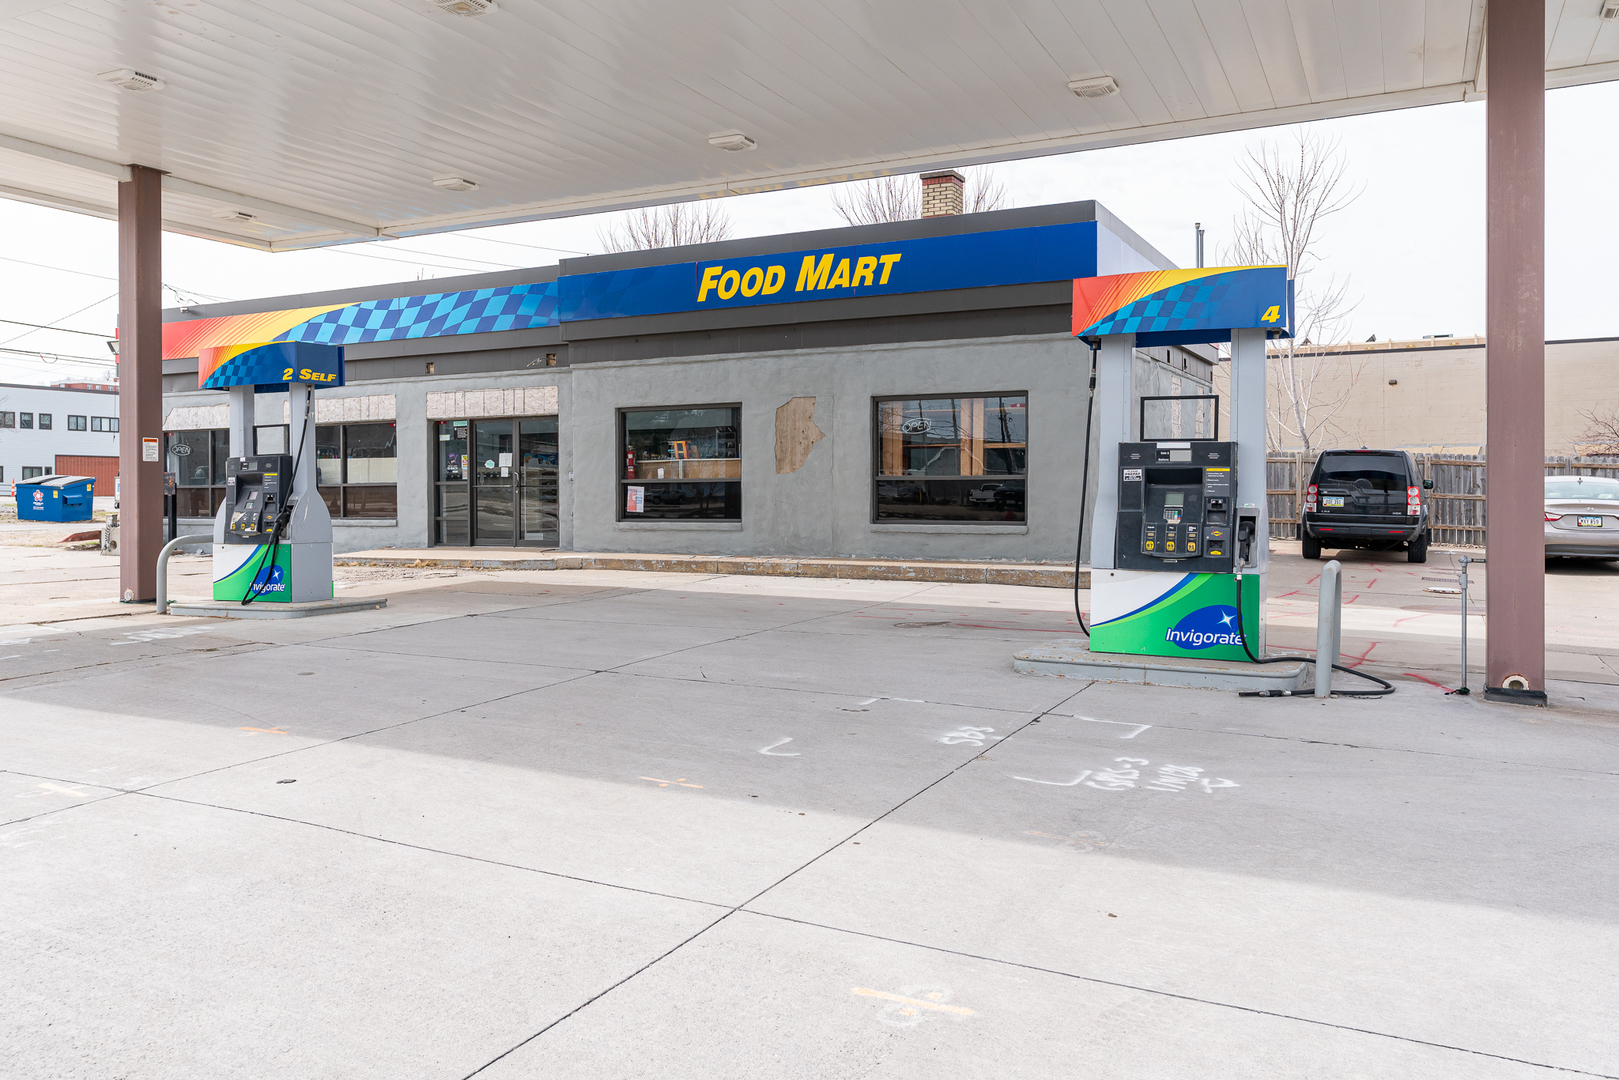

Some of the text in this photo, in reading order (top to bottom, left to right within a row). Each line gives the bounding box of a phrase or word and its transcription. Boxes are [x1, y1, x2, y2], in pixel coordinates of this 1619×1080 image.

[697, 253, 902, 302] FOOD MART
[1260, 305, 1281, 323] 4
[282, 367, 337, 382] 2 SELF
[902, 420, 930, 432] OPEN
[1165, 628, 1244, 646] Invigorate
